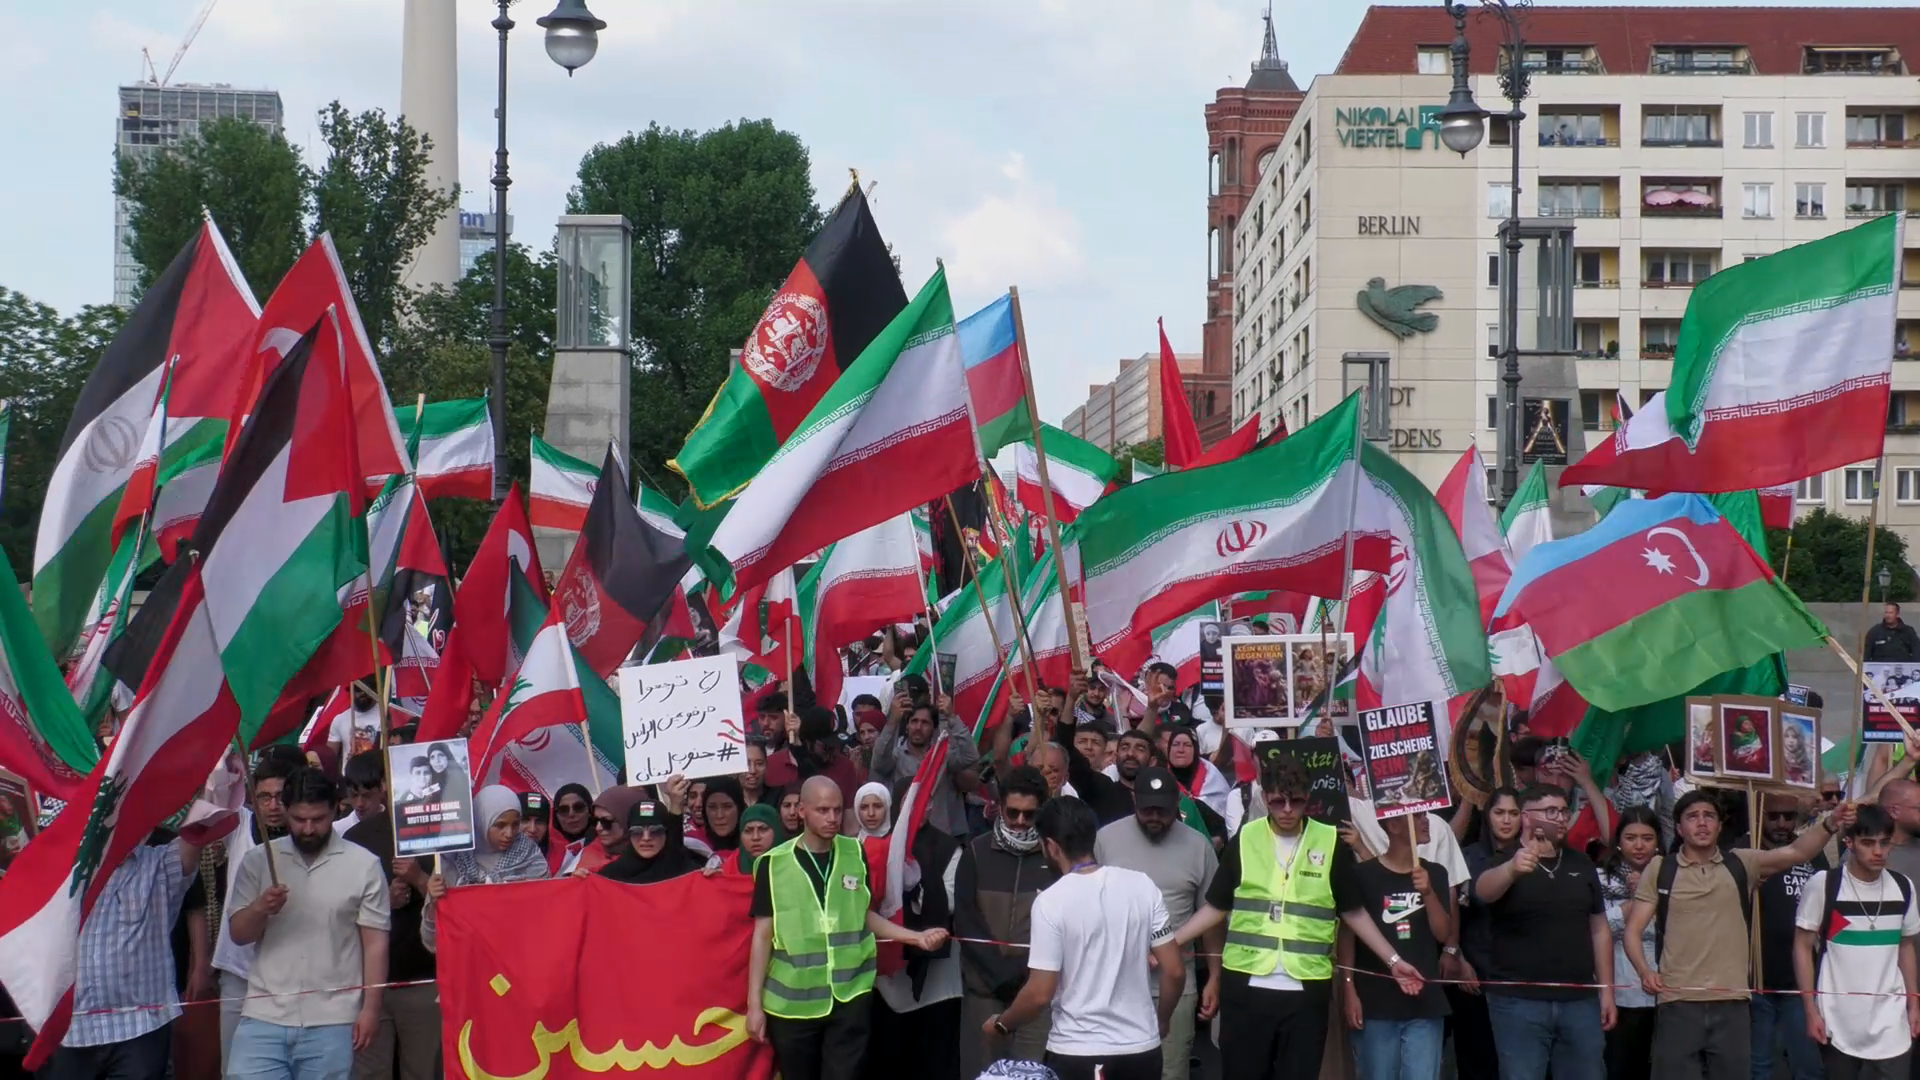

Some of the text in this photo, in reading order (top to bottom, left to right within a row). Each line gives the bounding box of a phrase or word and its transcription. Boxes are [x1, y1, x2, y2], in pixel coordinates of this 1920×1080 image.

[1336, 106, 1414, 127] NIKOLAI
[1336, 128, 1404, 148] VIERTEL
[1358, 215, 1421, 235] BERLIN
[1235, 651, 1284, 660] GEGEN IRAN
[1236, 644, 1281, 653] KEIN KRIEG
[1365, 703, 1428, 731] GLAUBE
[1369, 736, 1434, 760] ZIELSCHEIBE
